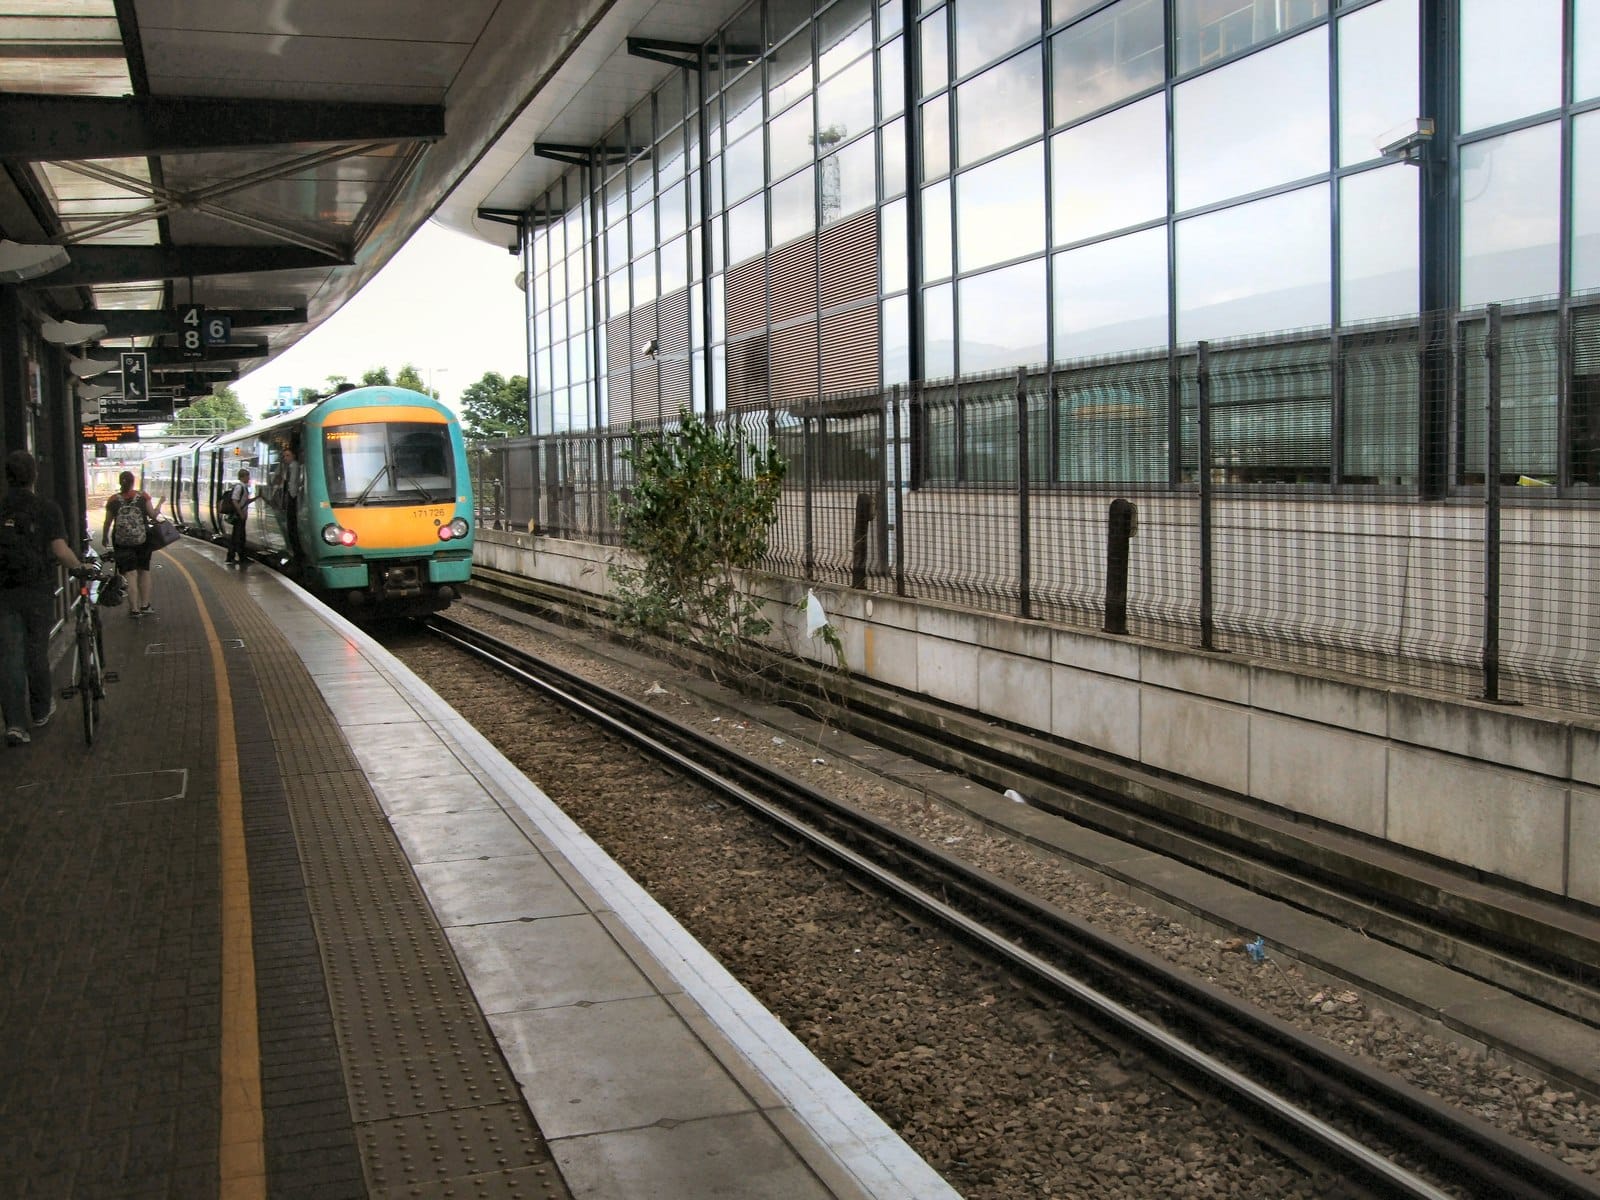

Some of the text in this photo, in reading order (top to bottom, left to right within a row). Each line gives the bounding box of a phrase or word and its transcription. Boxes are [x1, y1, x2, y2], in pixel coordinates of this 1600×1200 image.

[183, 308, 200, 327] 4
[209, 319, 225, 338] 6
[184, 330, 200, 349] 8
